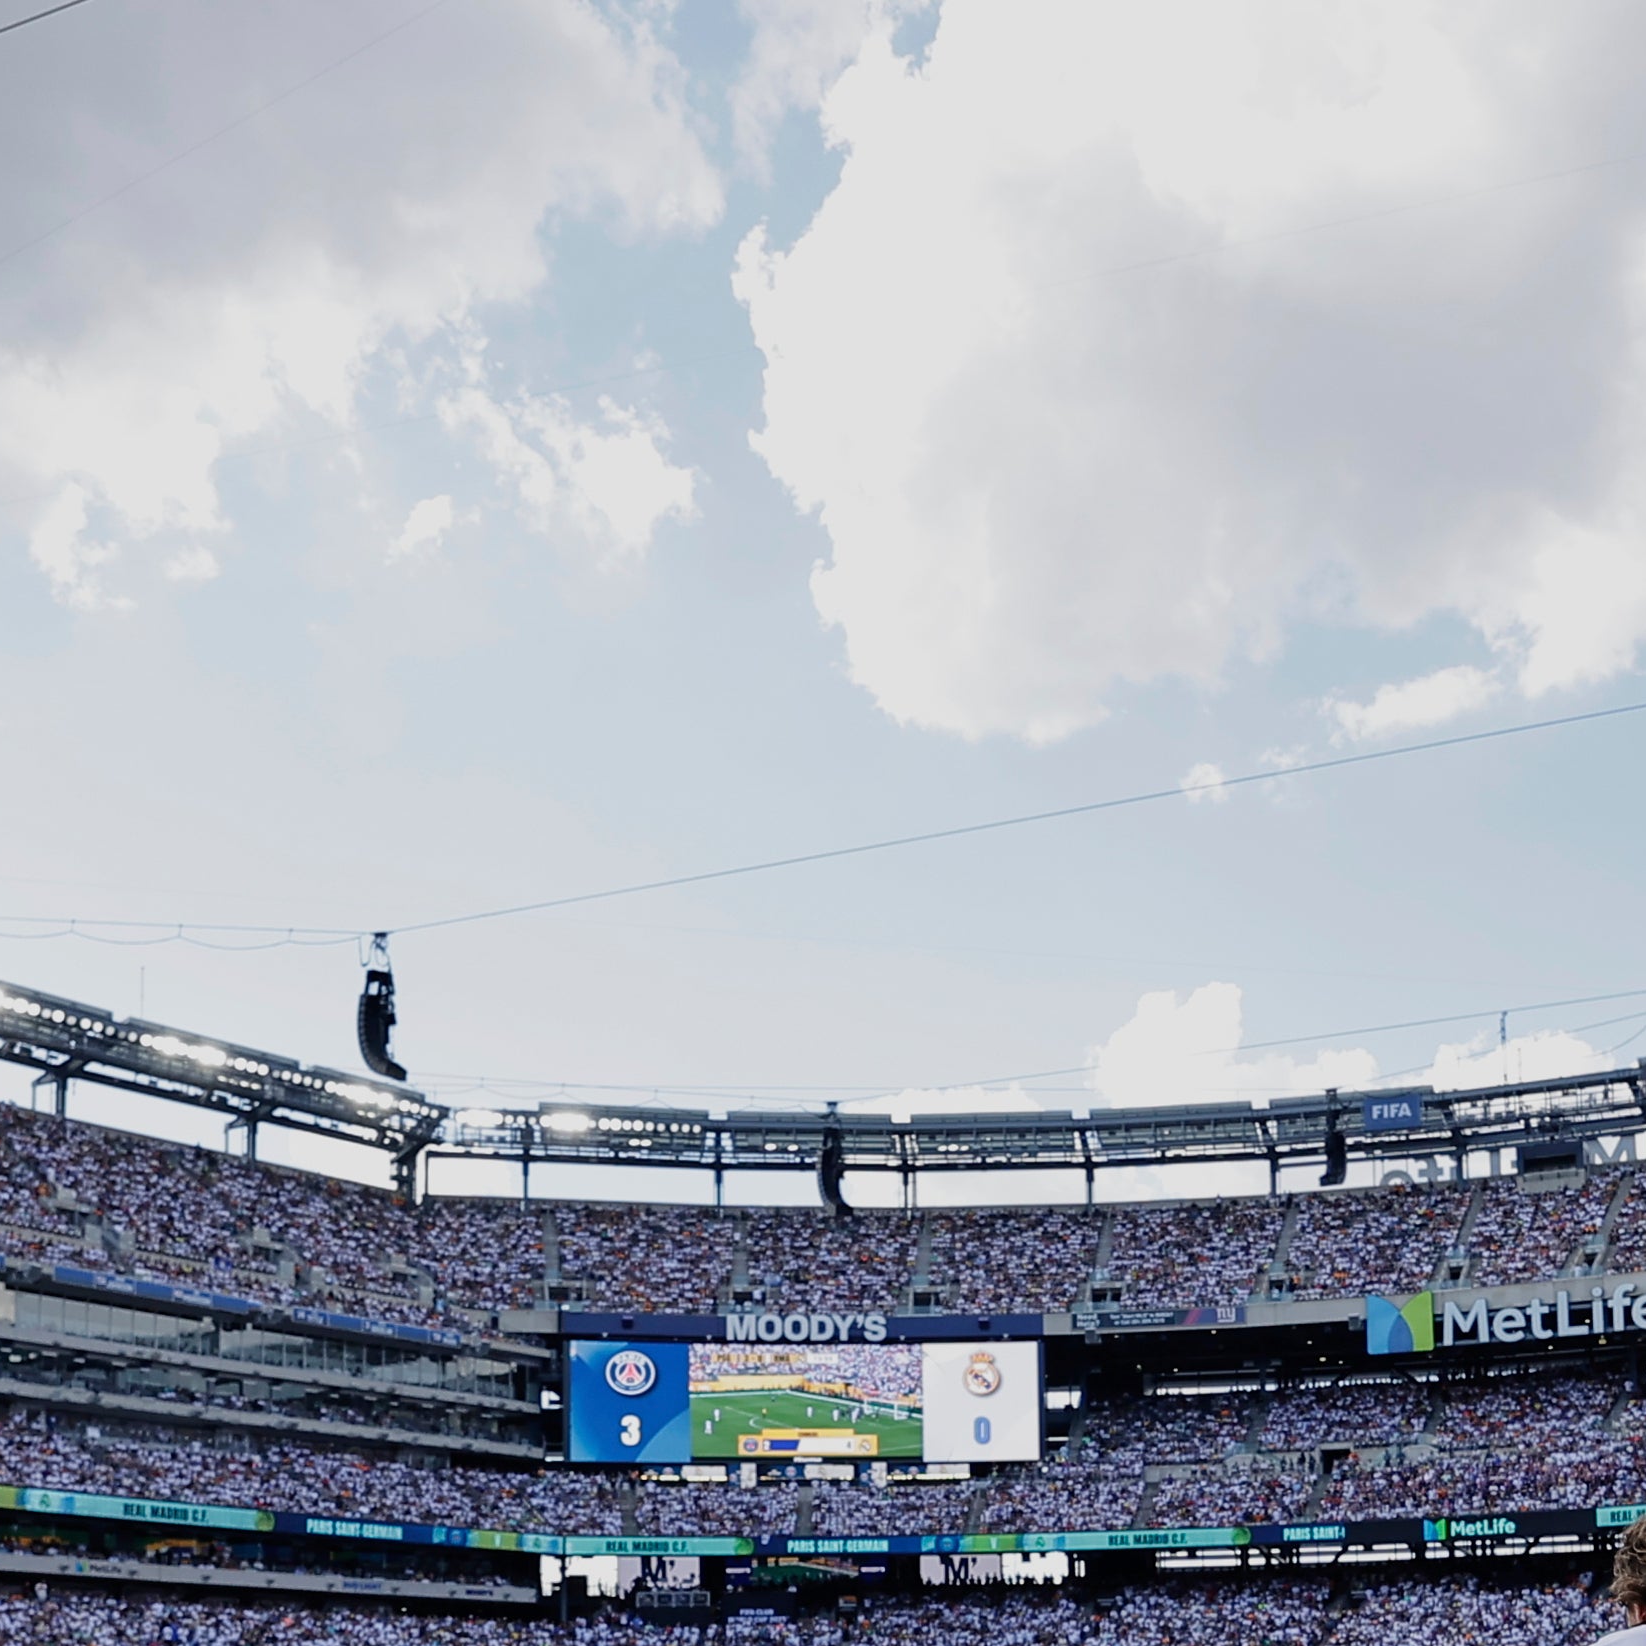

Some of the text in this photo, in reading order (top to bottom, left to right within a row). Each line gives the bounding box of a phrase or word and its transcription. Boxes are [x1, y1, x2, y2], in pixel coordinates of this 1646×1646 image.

[1371, 1102, 1412, 1121] FIFA
[725, 1314, 888, 1343] MOODY'S
[620, 1414, 642, 1446] 3
[973, 1416, 992, 1445] 0
[123, 1503, 146, 1518] REAL
[1610, 1510, 1633, 1523] REAL
[306, 1518, 403, 1541] PARIS SAINT-GERMAIN
[1283, 1526, 1345, 1541] PARIS SAINT-
[1450, 1518, 1516, 1538] MetLife
[605, 1541, 628, 1553] REAL
[632, 1541, 669, 1553] MADRID
[787, 1539, 889, 1553] PARIS SAINT-GERMAIN
[1108, 1534, 1130, 1547] REAL
[1133, 1533, 1169, 1546] MADRID
